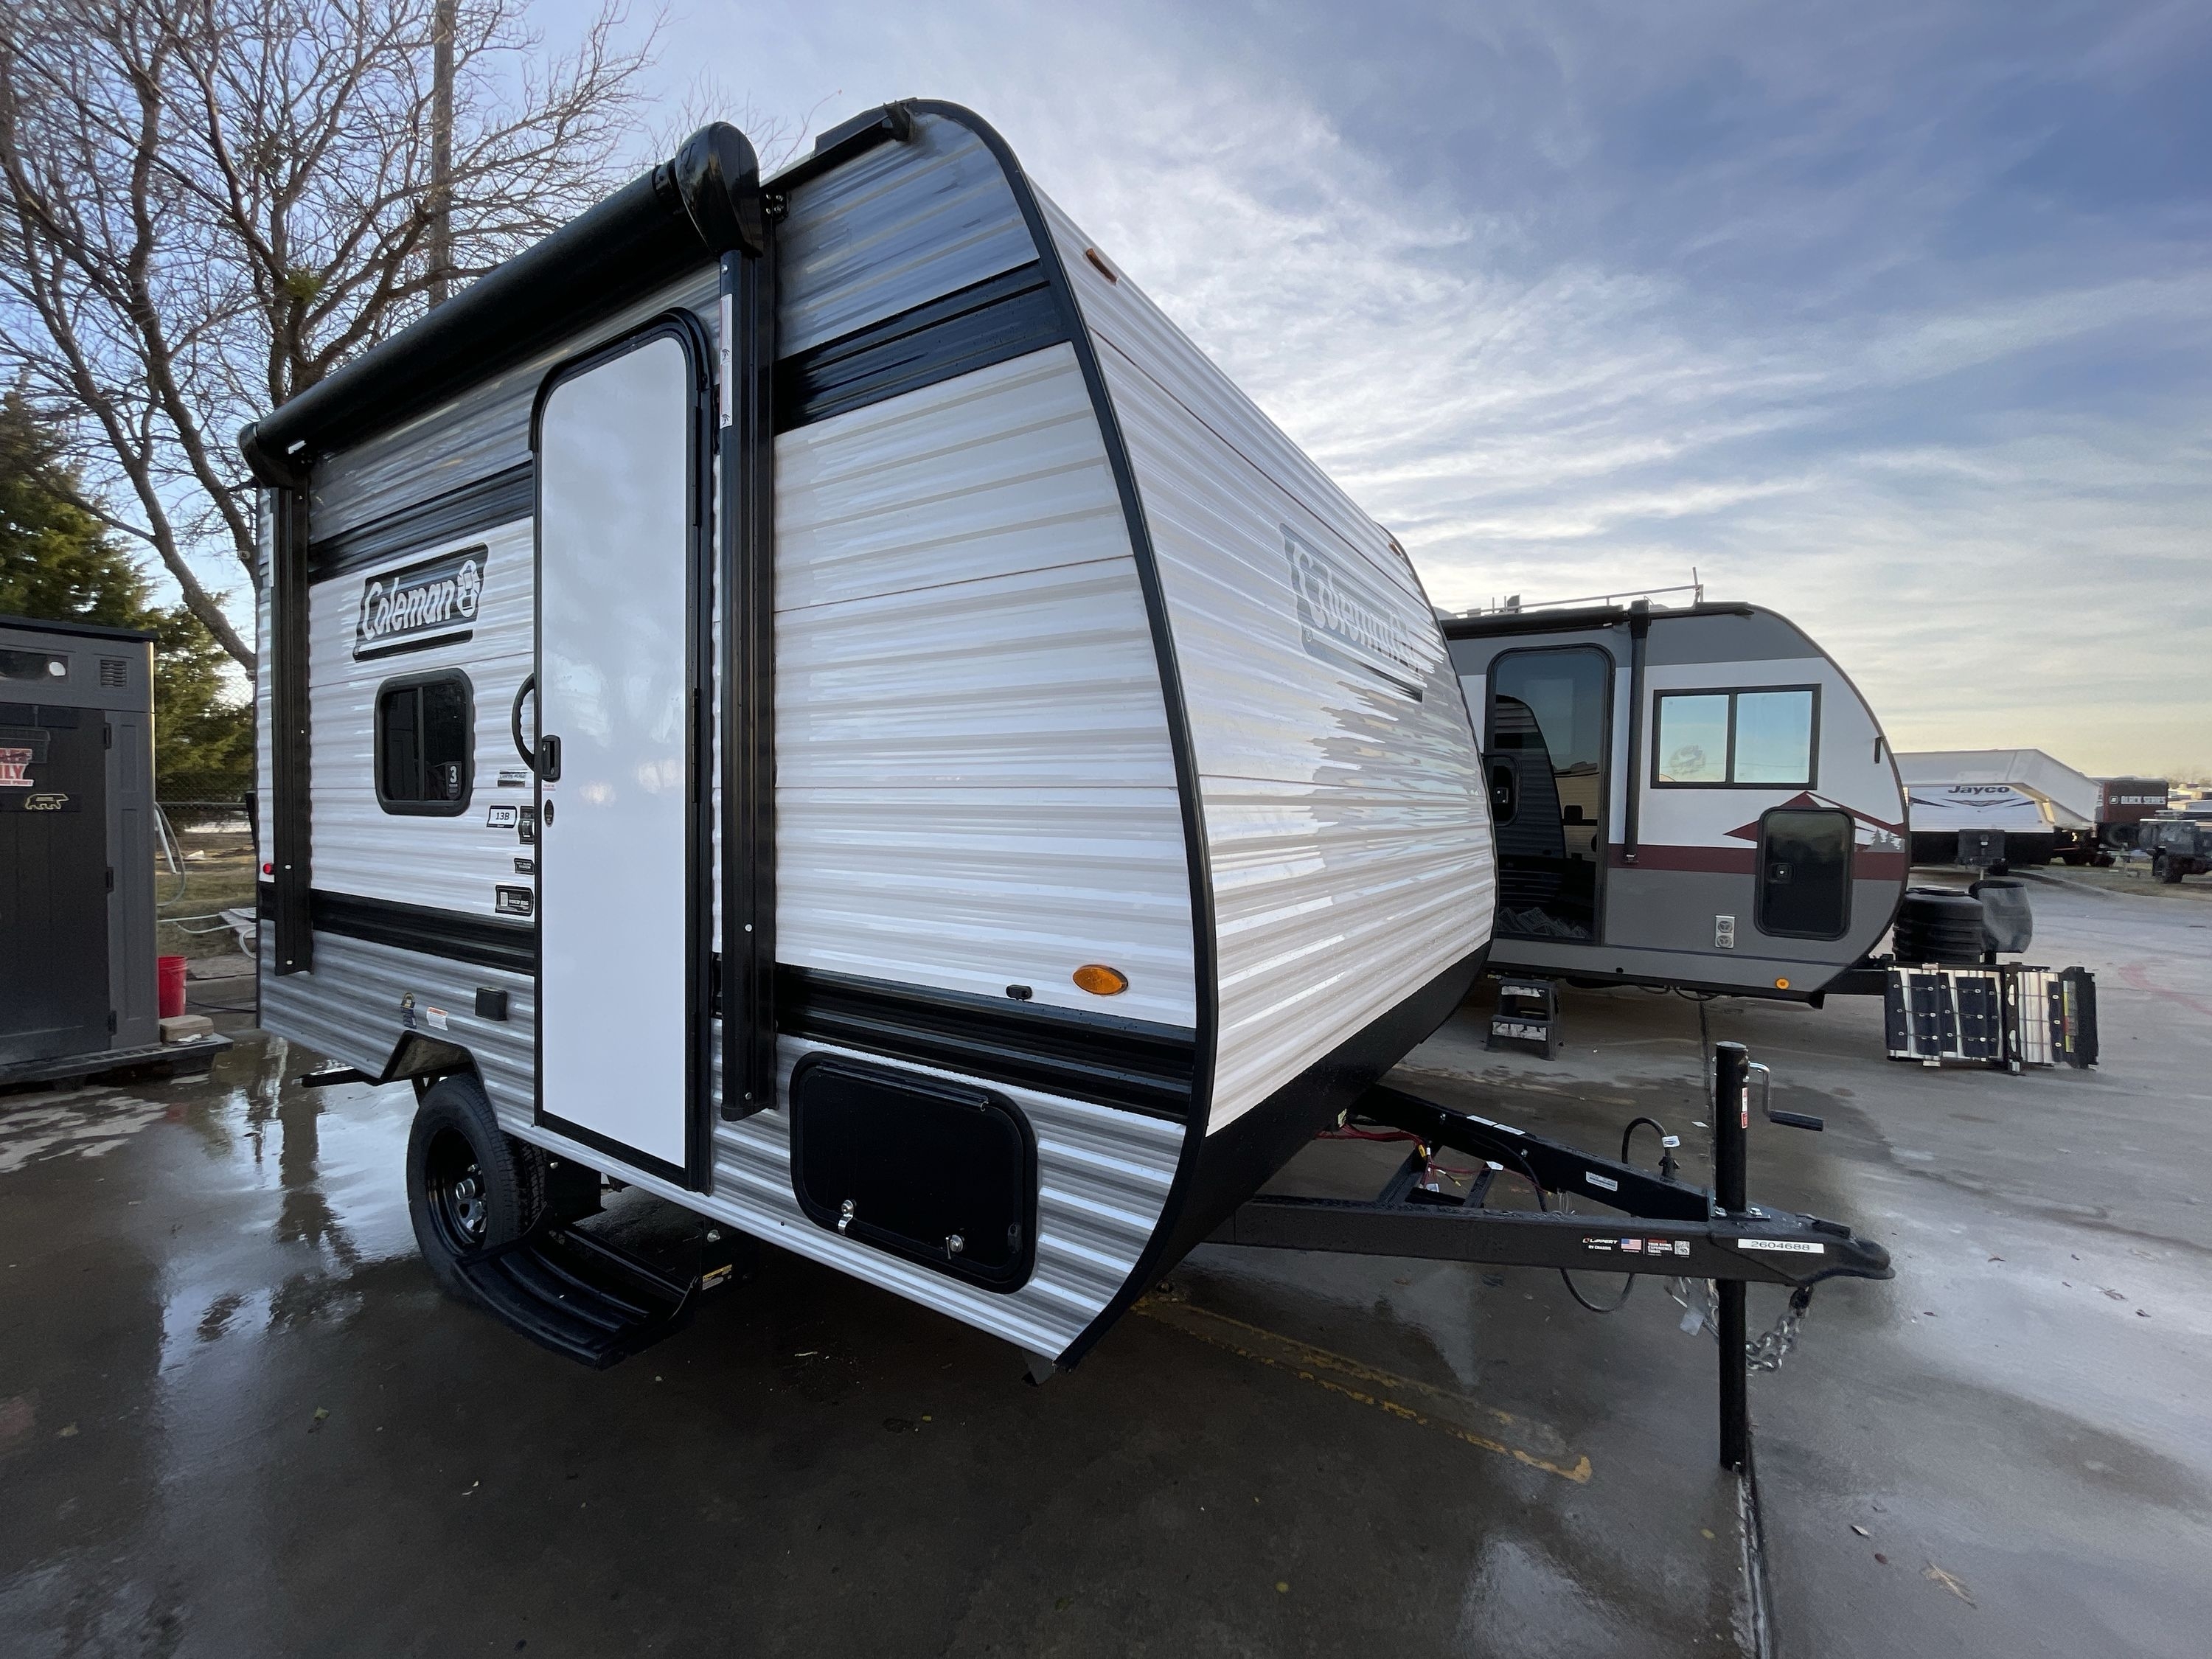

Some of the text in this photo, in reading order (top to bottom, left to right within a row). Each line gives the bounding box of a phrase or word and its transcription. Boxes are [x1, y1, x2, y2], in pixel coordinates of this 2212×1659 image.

[363, 577, 456, 641] Coleman
[450, 766, 457, 783] 3
[1948, 785, 2010, 795] Jayco
[495, 812, 510, 821] 13B
[1751, 1241, 1810, 1251] 2604688
